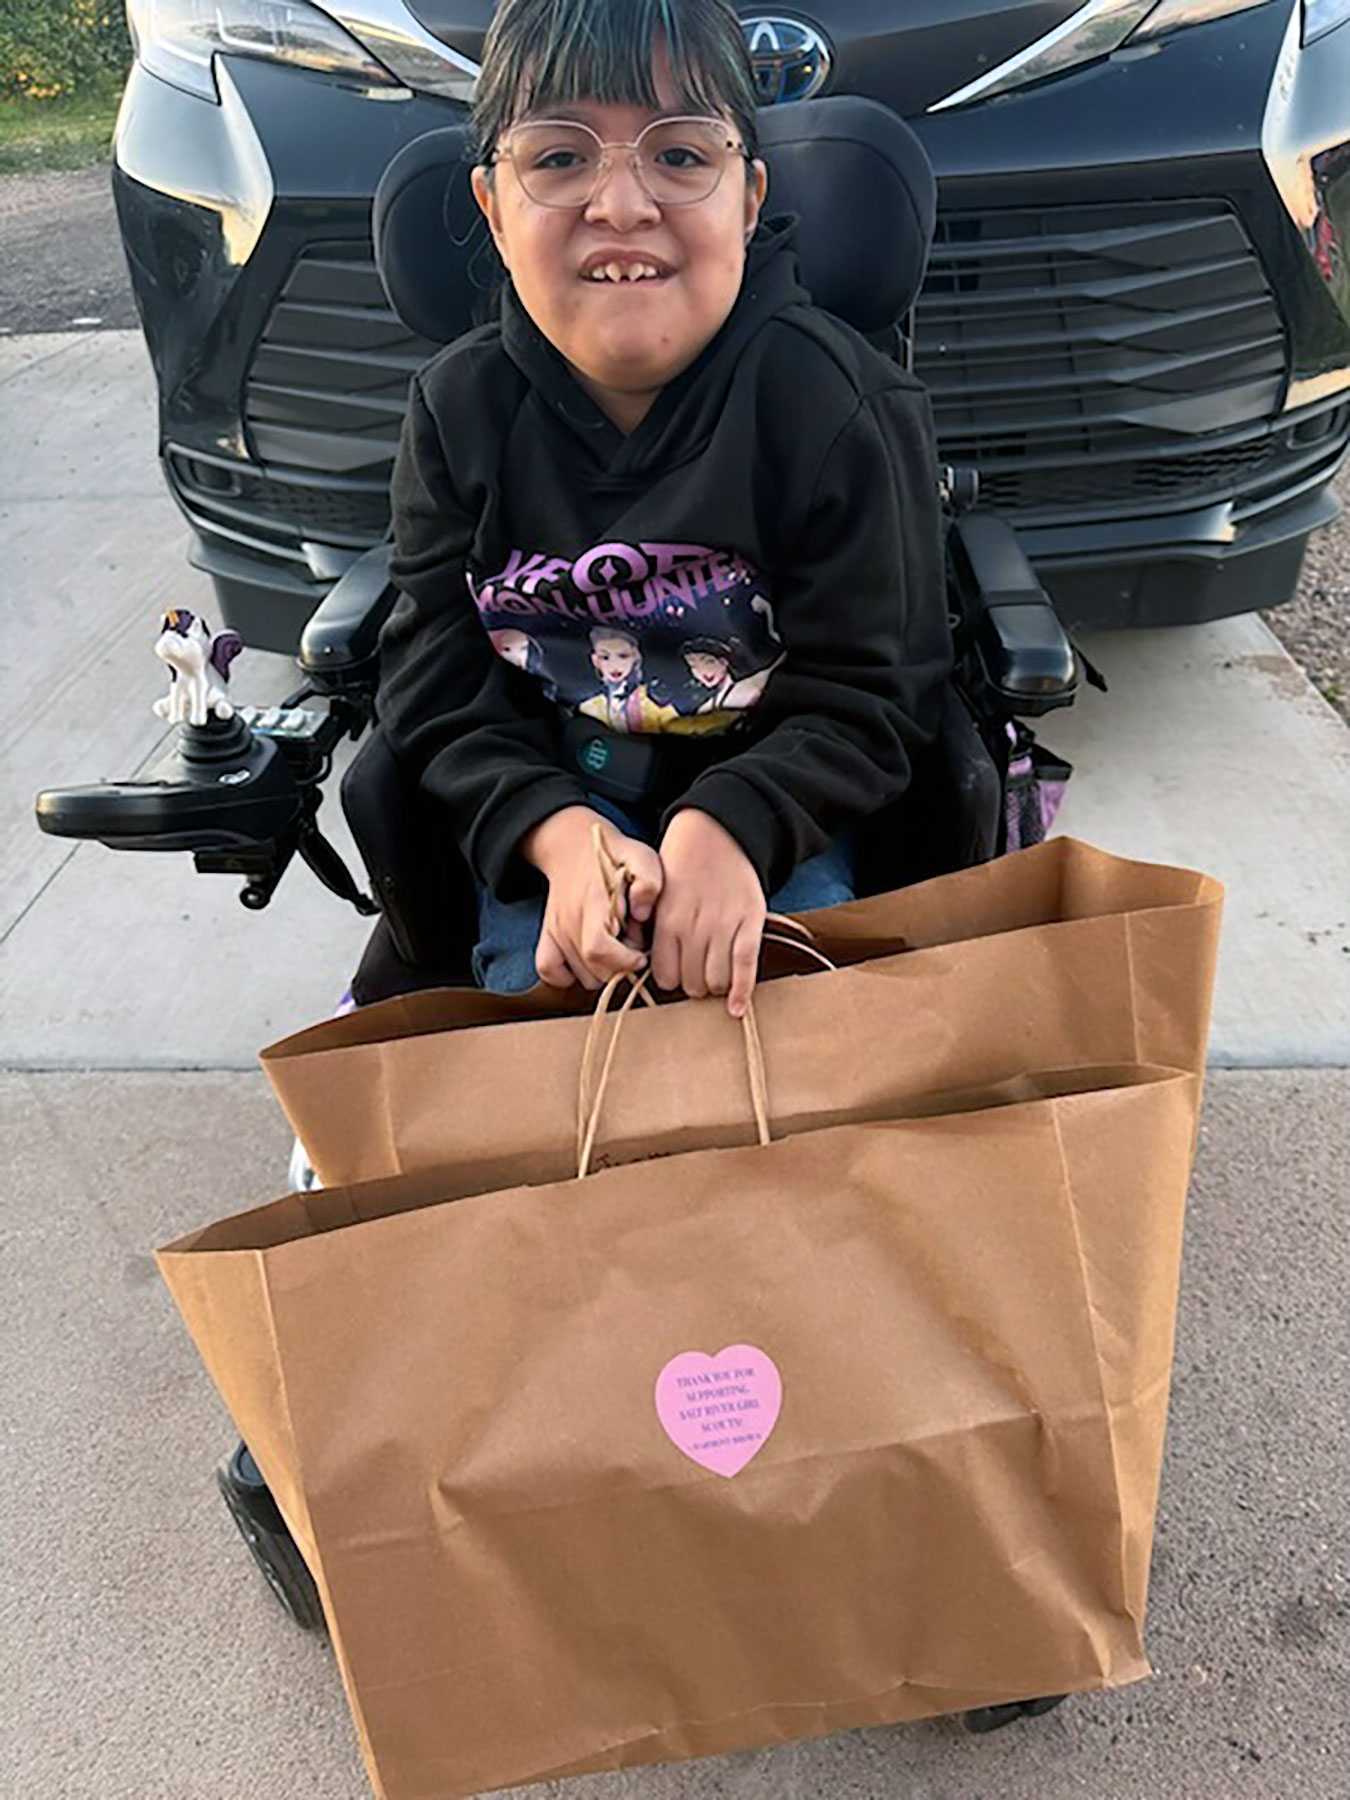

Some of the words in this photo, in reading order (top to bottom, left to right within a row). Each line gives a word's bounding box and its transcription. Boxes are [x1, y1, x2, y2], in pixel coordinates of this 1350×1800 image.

[676, 1374, 712, 1387] THANK
[713, 1371, 730, 1382] YOU
[734, 1367, 755, 1378] FOR
[686, 1385, 750, 1401] SUPPORTING
[705, 1402, 735, 1416] RIVER
[737, 1399, 759, 1410] GIRL
